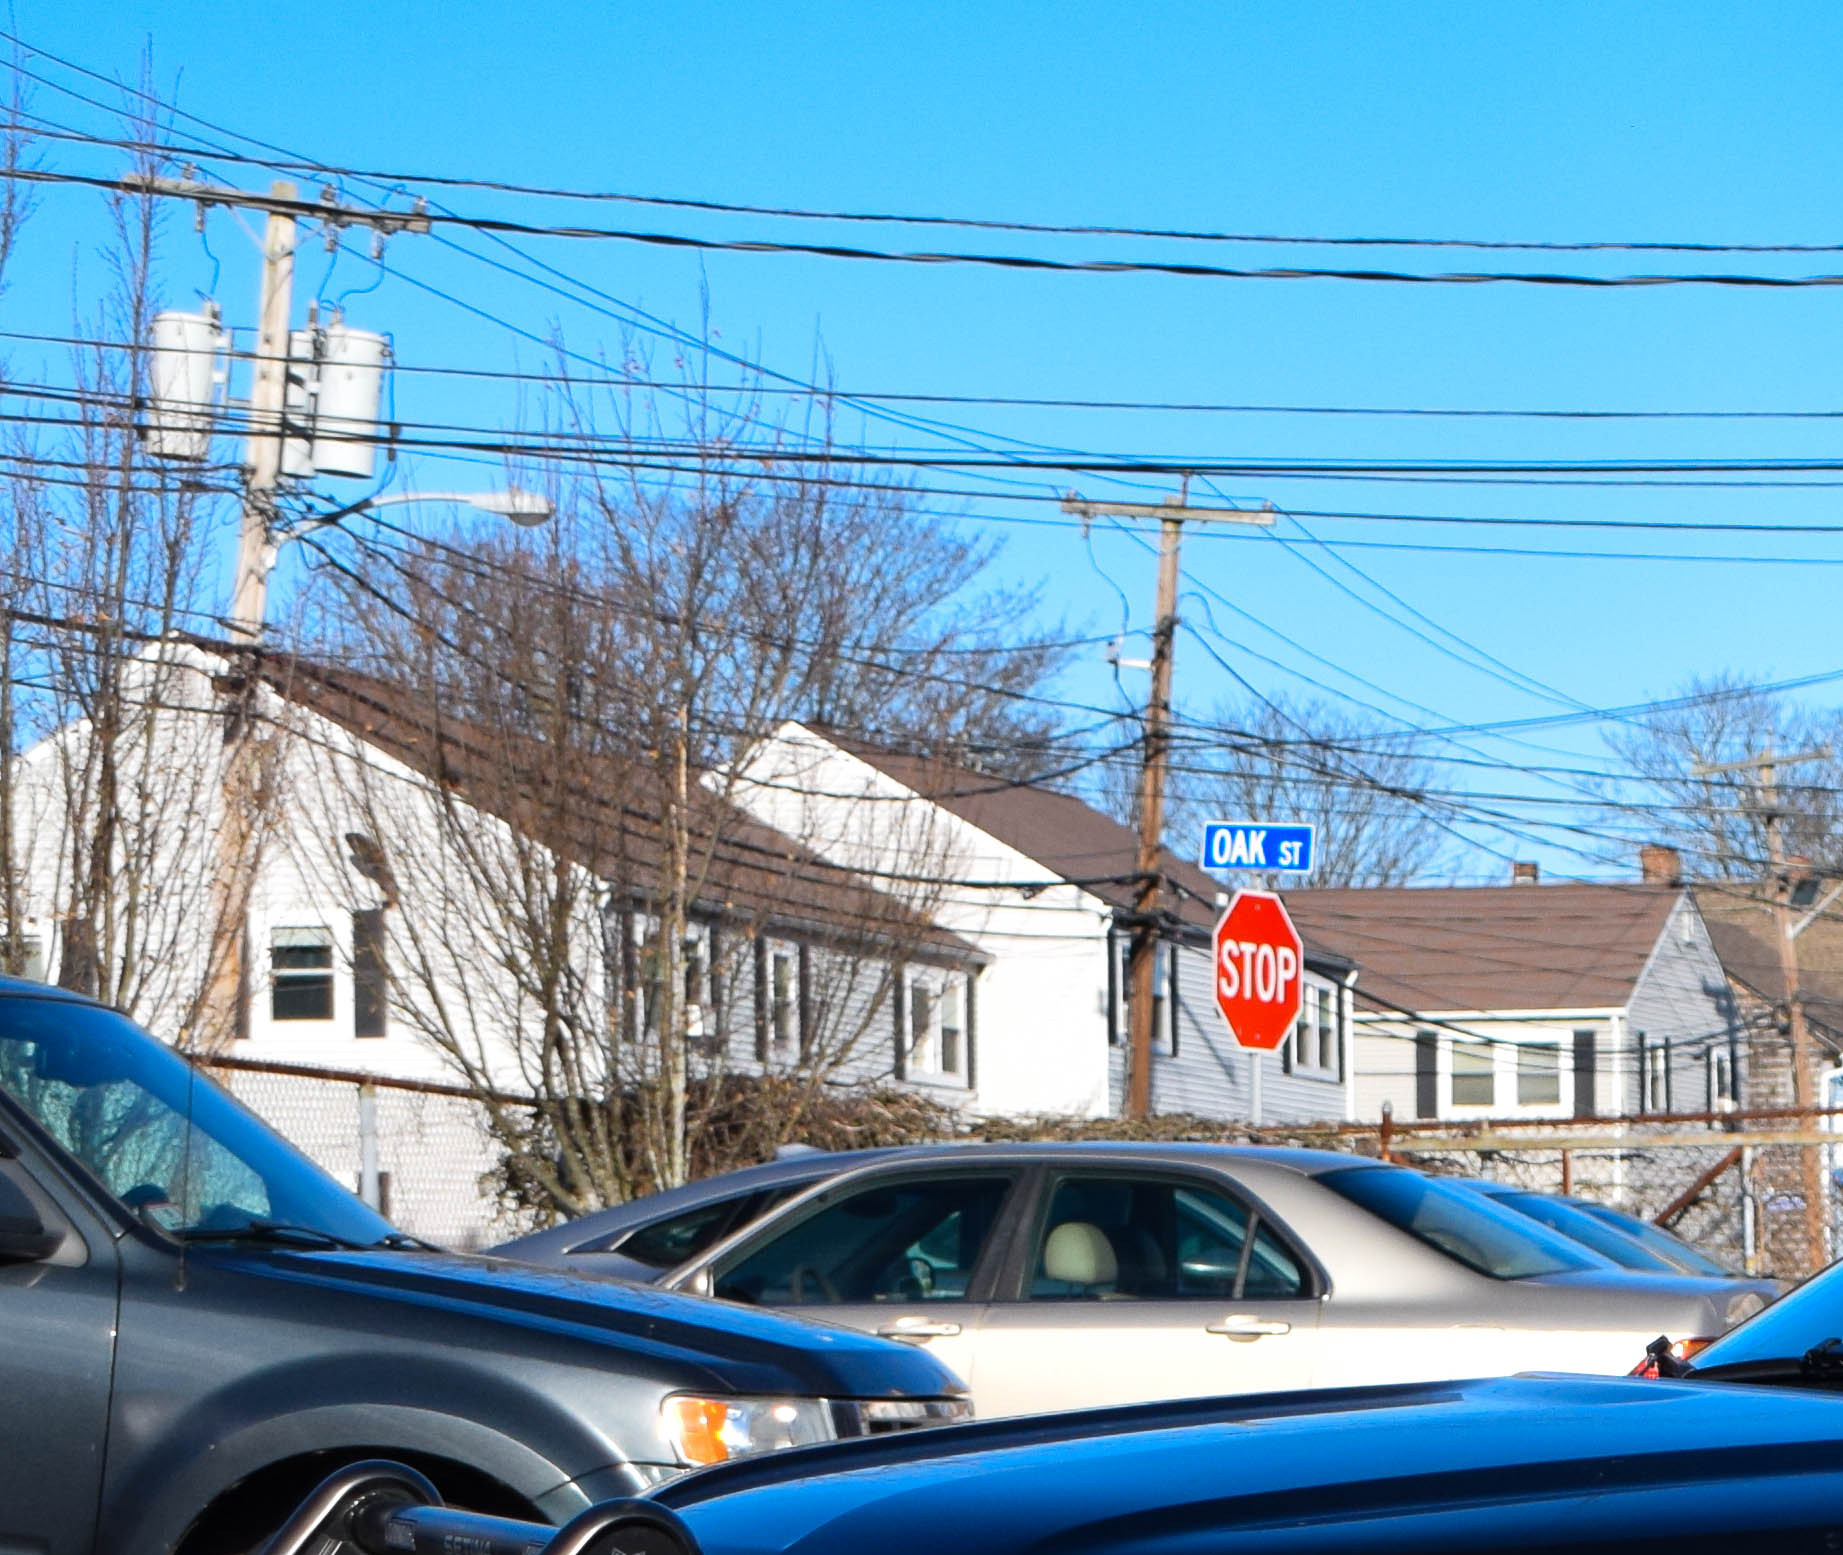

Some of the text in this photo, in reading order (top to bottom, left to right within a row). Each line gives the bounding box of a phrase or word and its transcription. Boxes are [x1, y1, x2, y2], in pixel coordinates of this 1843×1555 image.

[1212, 828, 1303, 866] OAK ST
[1219, 939, 1297, 1003] STOP
